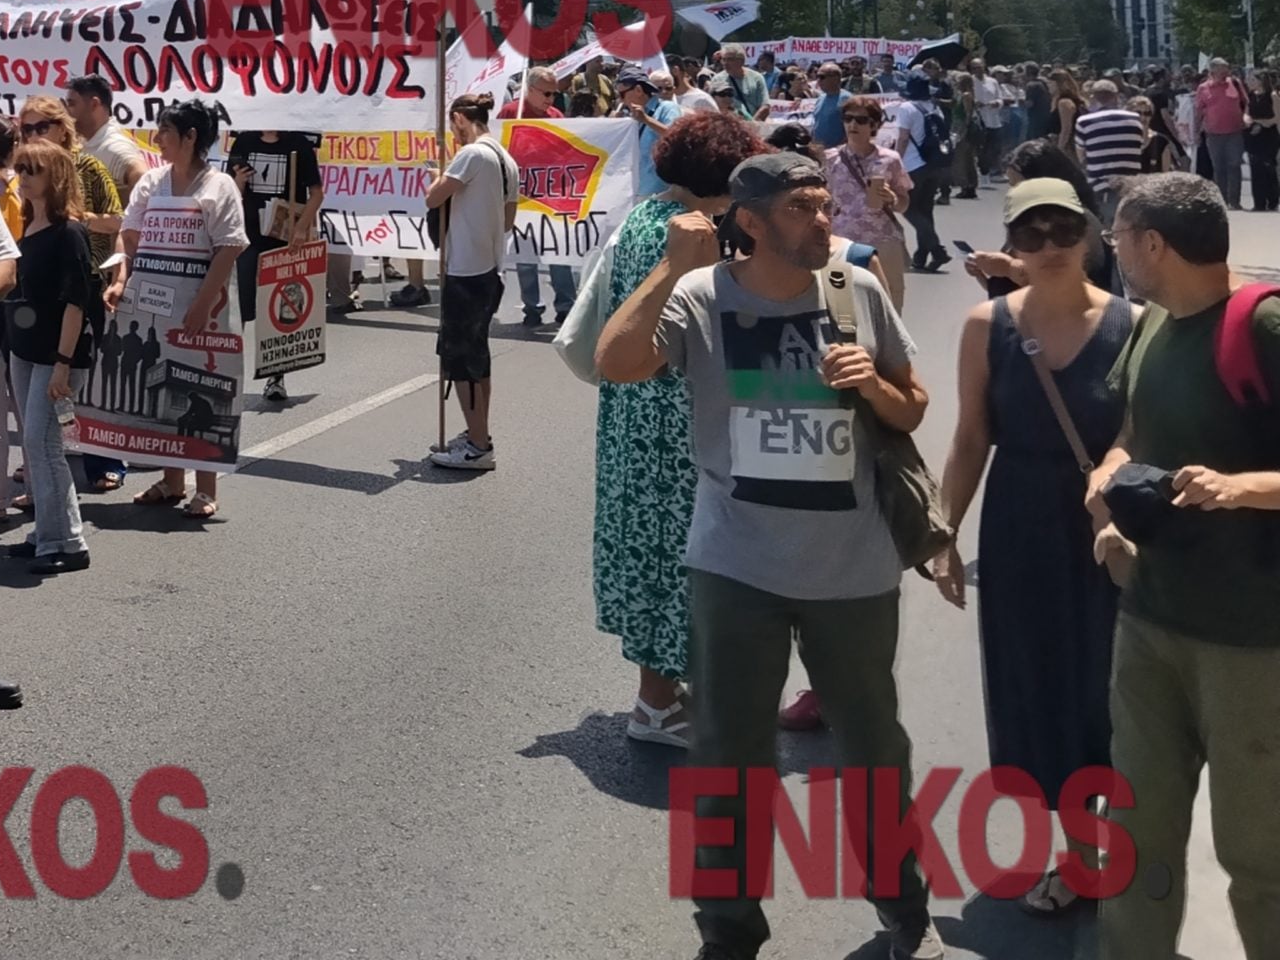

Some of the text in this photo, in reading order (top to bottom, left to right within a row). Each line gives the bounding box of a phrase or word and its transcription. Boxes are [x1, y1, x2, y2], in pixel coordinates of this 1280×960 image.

[791, 39, 857, 54] ΑΝΑΘΕΩΡΗΣΗ
[863, 41, 880, 54] ΤΟΥ
[85, 39, 425, 99] ΔΟΛΟΦΟΝΟΥΣ
[325, 135, 381, 161] ΤΙΚΟΣ
[320, 165, 428, 198] ΠΡΑΓΜΑΤΙΚ
[519, 164, 587, 198] ΗΣΕΙΣ
[163, 217, 204, 230] ΠΡΟΚΗΡ
[365, 218, 394, 244] ΤΟΥ
[141, 230, 195, 244] ΡΟΥΣ ΑΣΕΠ
[196, 335, 204, 346] ΤΙ
[260, 327, 322, 351] ΔΟΛΟΦΟΝΩΝ
[262, 340, 320, 363] ΚΥΒΕΡΝΗΣΗ
[171, 366, 199, 384] ΤΑΜΕΙΟ
[88, 426, 126, 448] ΤΑΜΕΙΟ
[128, 434, 186, 455] ΑΝΕΡΓΙΑΣ
